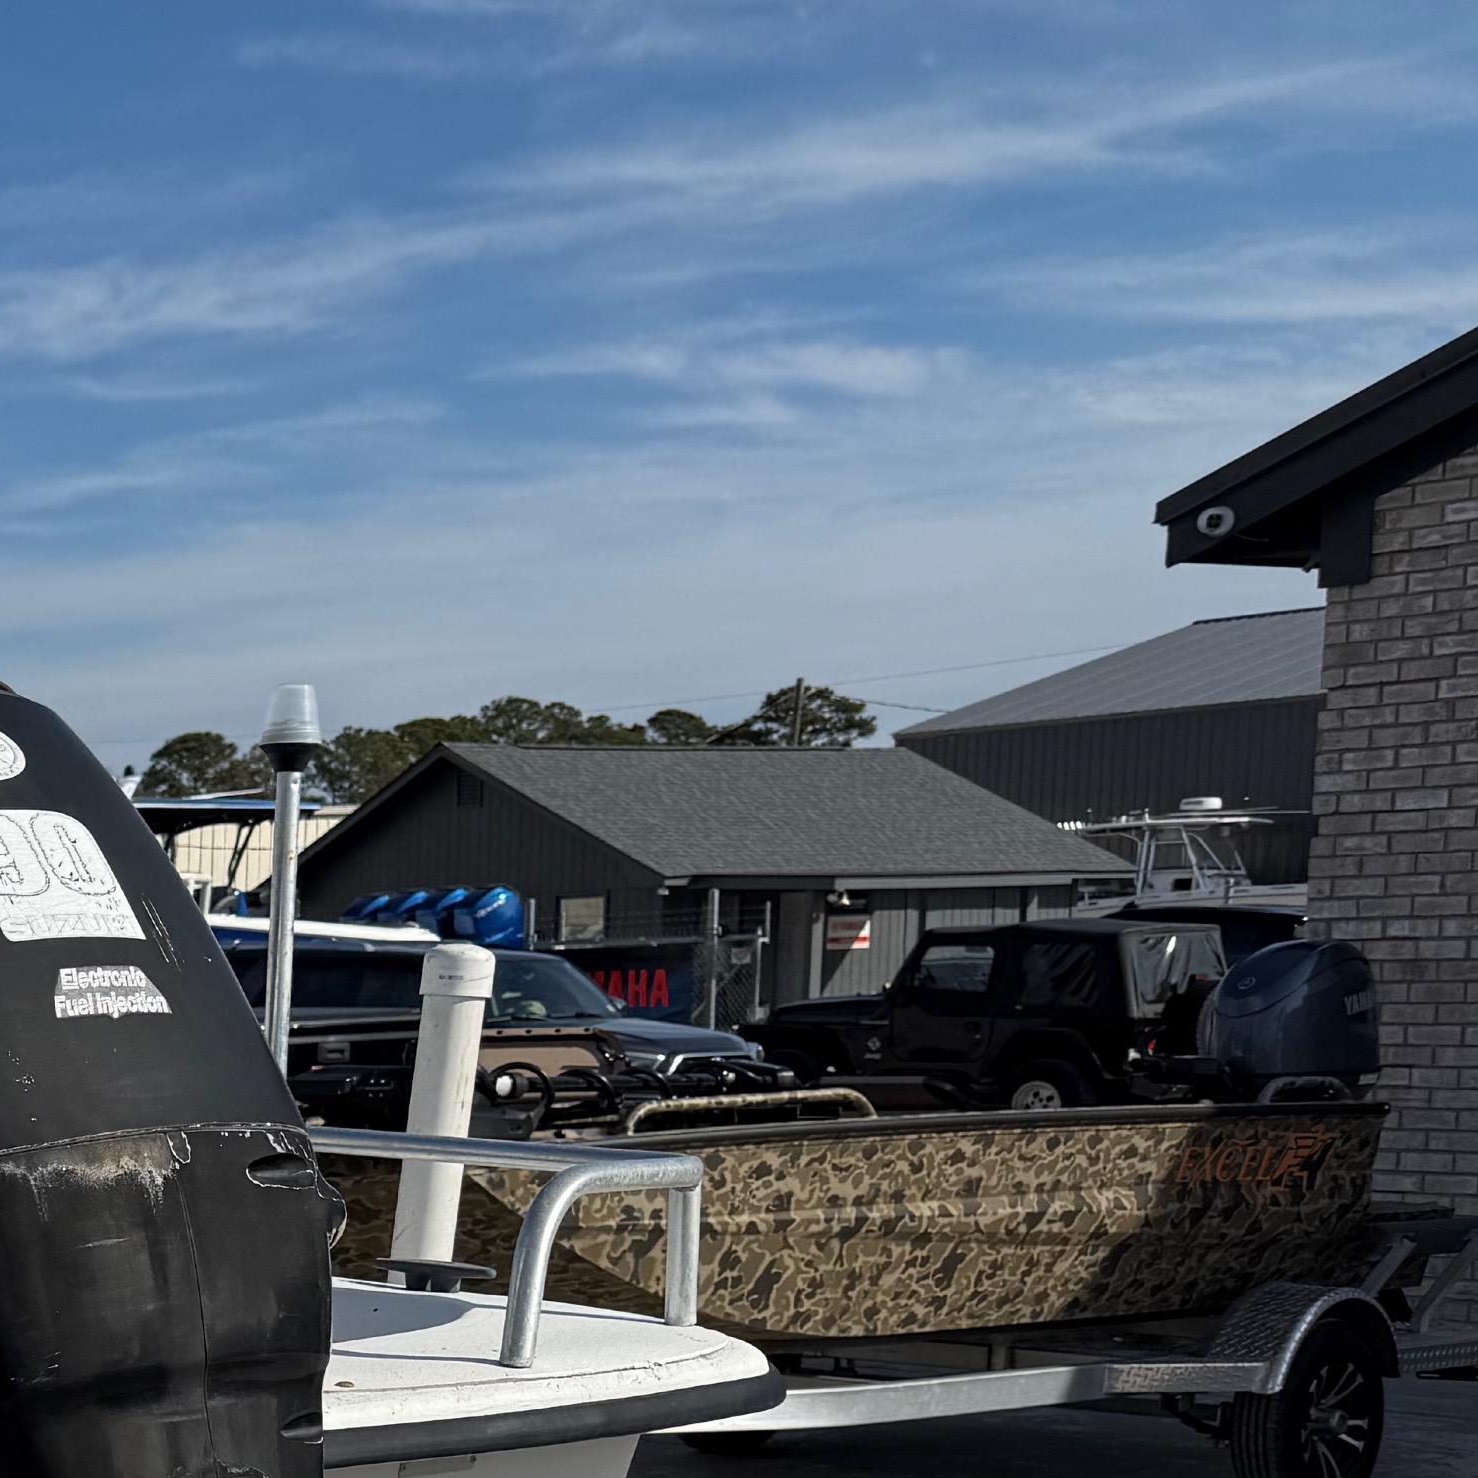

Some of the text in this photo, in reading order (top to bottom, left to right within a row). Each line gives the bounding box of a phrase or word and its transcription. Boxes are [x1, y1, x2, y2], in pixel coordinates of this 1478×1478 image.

[59, 966, 146, 990] Electronic
[54, 991, 171, 1018] Fuel Injection
[1176, 1142, 1274, 1189] EXCEL
